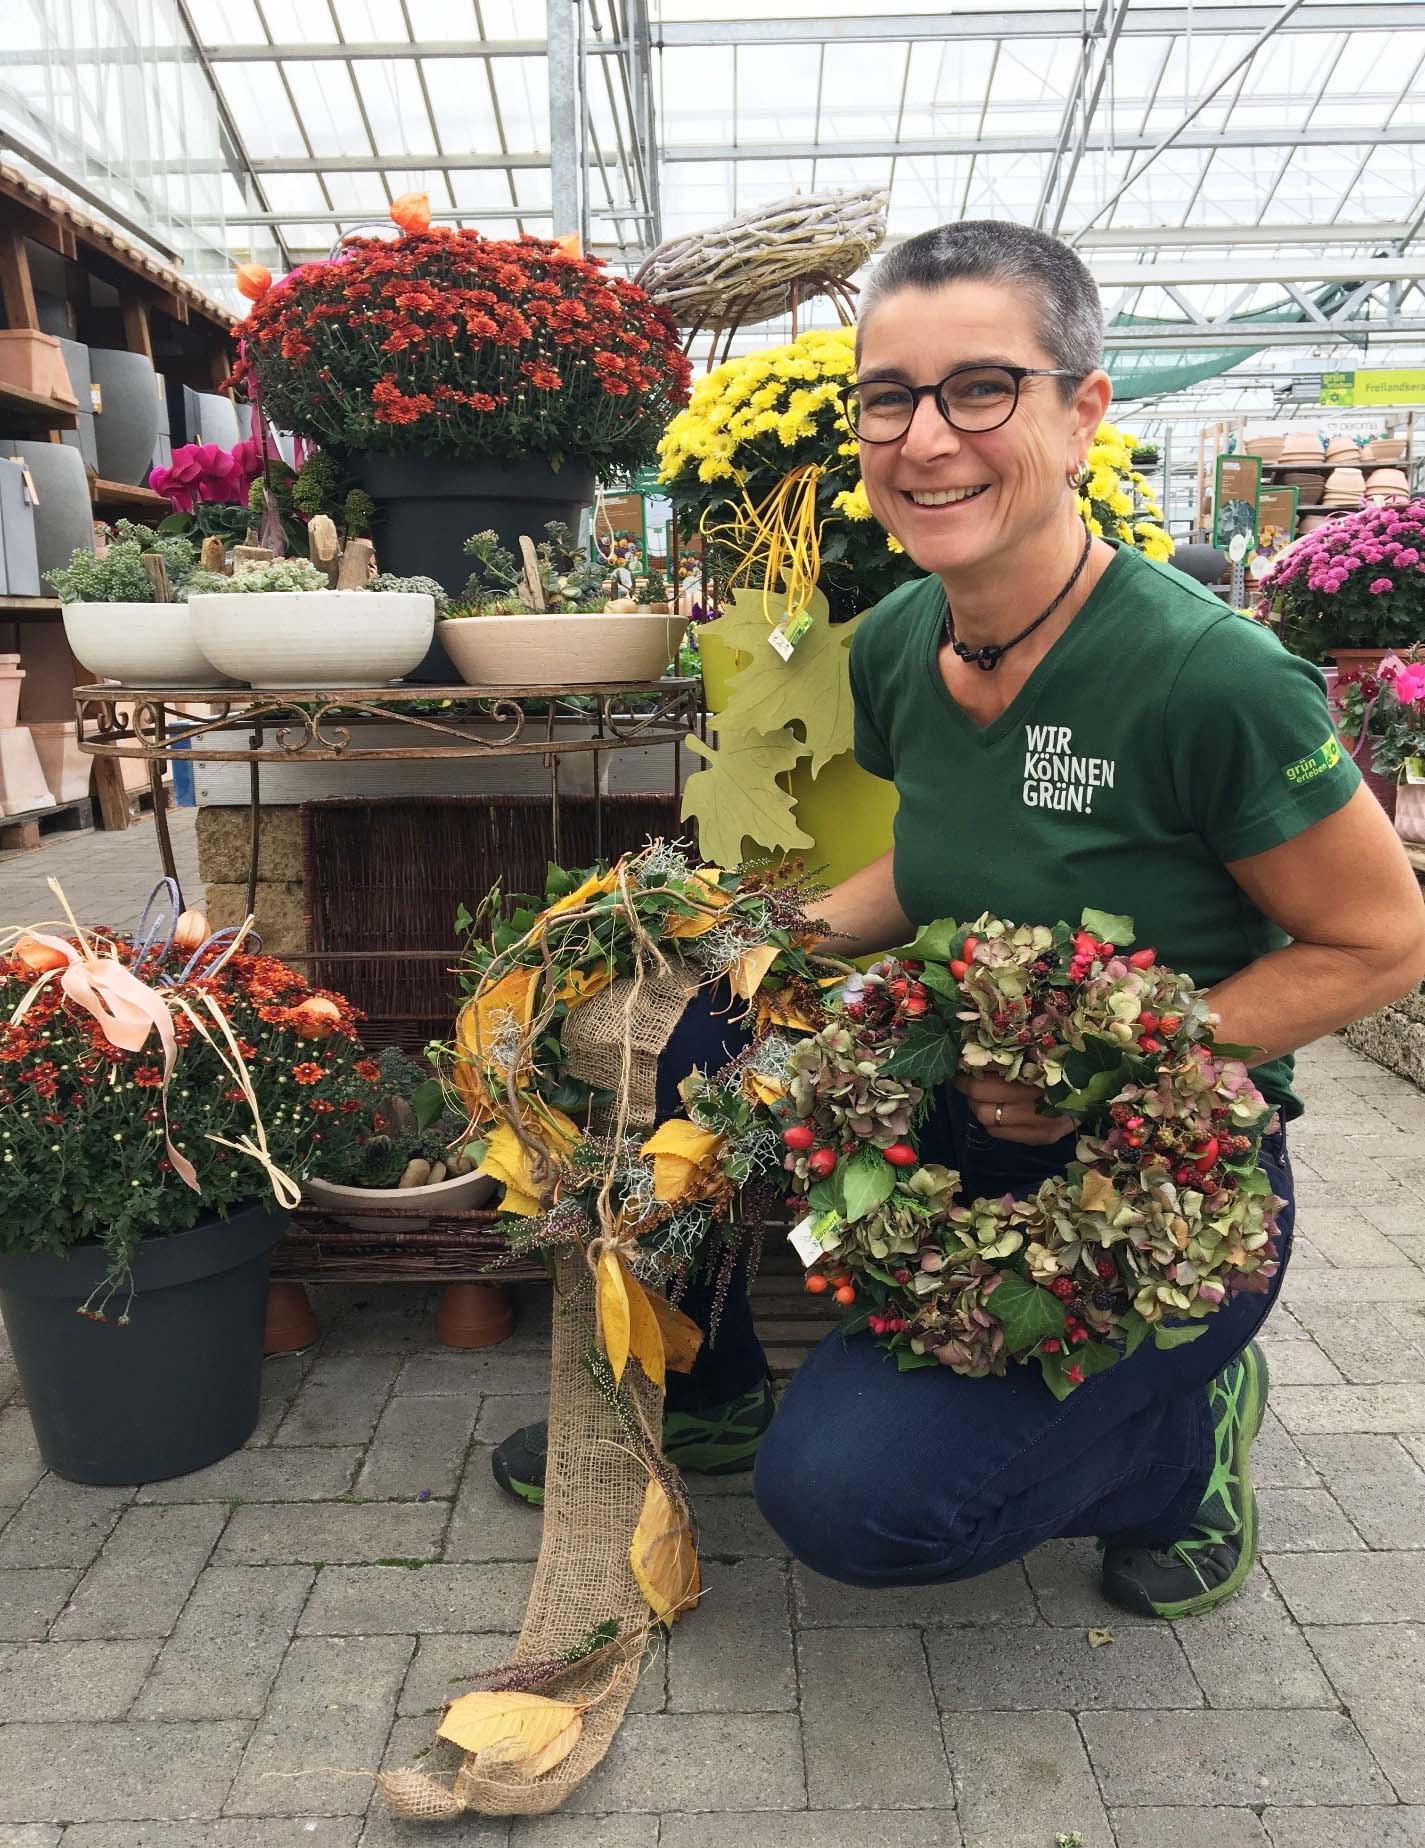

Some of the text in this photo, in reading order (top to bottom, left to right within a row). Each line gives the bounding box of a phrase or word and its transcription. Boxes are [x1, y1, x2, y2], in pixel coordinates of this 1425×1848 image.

[1025, 724, 1072, 755] WIR
[1286, 758, 1317, 780] grün
[1296, 763, 1328, 783] erleben
